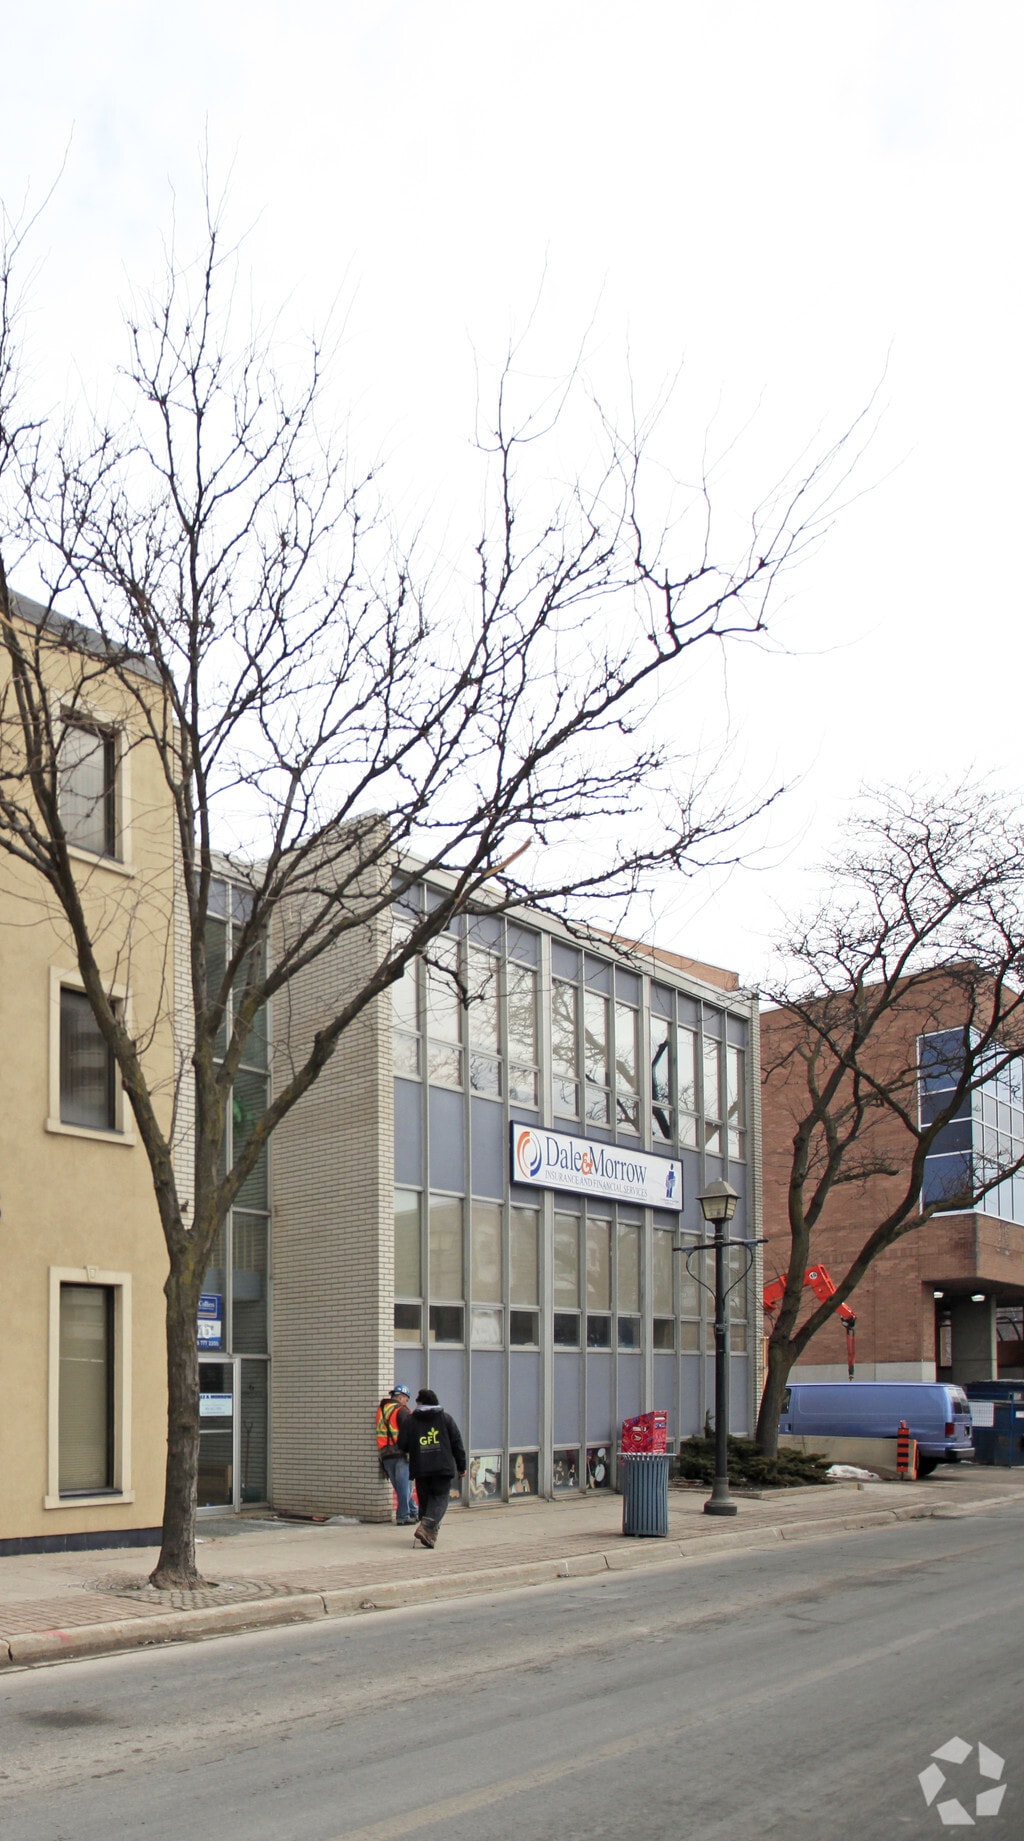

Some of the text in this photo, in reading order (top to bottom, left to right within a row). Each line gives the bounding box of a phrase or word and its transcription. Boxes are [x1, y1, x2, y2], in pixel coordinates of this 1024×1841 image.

[545, 1170, 648, 1198] INSURANCE AND FINANCIAL SERVICES
[419, 1430, 440, 1446] GFL
